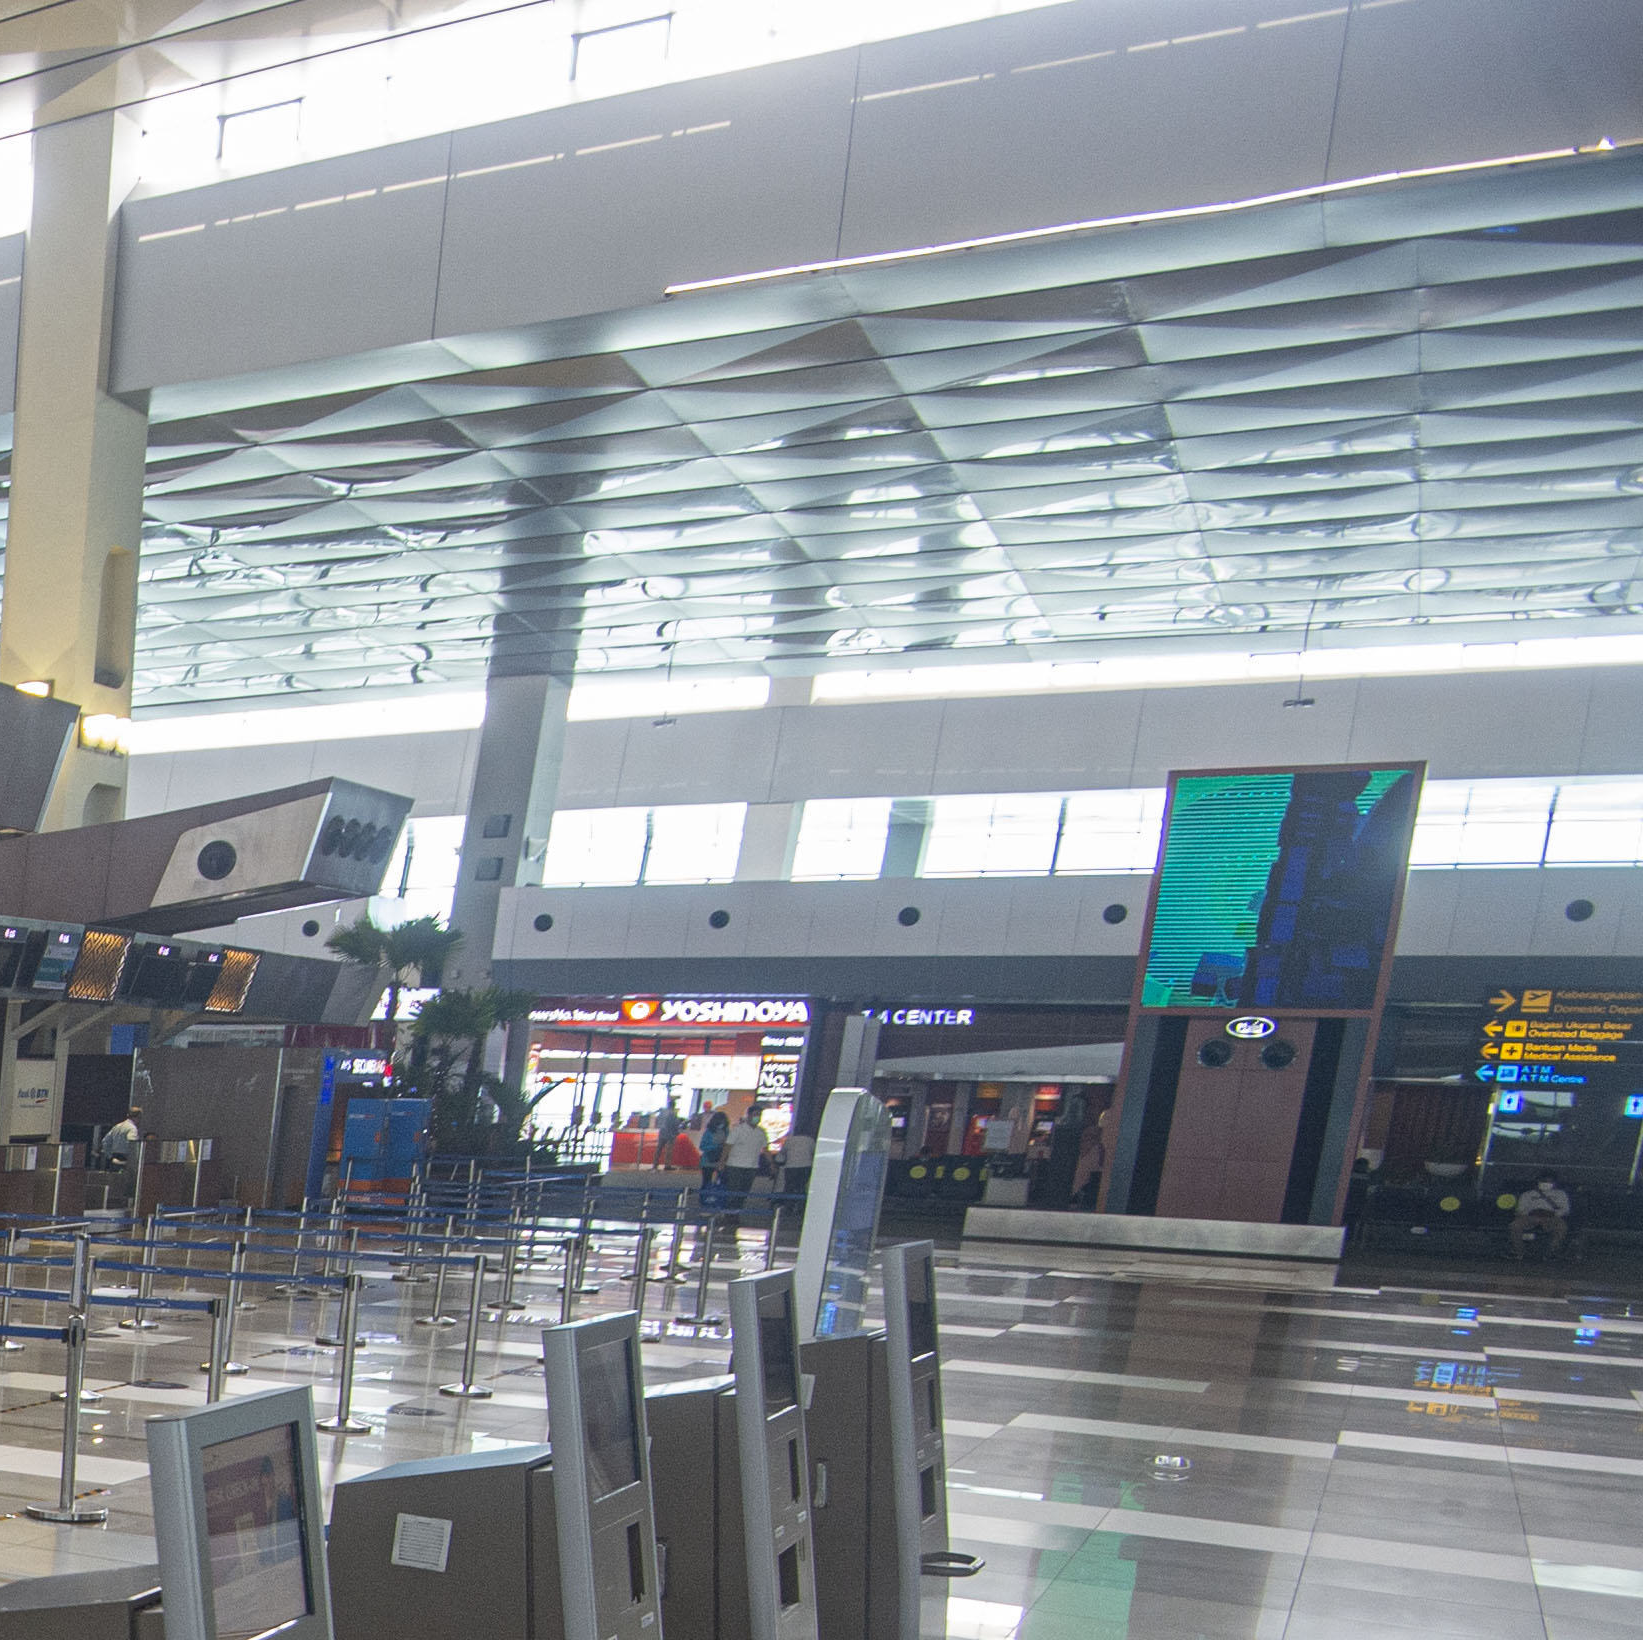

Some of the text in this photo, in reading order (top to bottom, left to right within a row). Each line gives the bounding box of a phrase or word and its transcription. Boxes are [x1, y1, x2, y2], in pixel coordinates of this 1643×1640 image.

[660, 1000, 809, 1022] YOSHINOYA
[892, 1008, 974, 1025] CENTER
[758, 1071, 798, 1088] No.1
